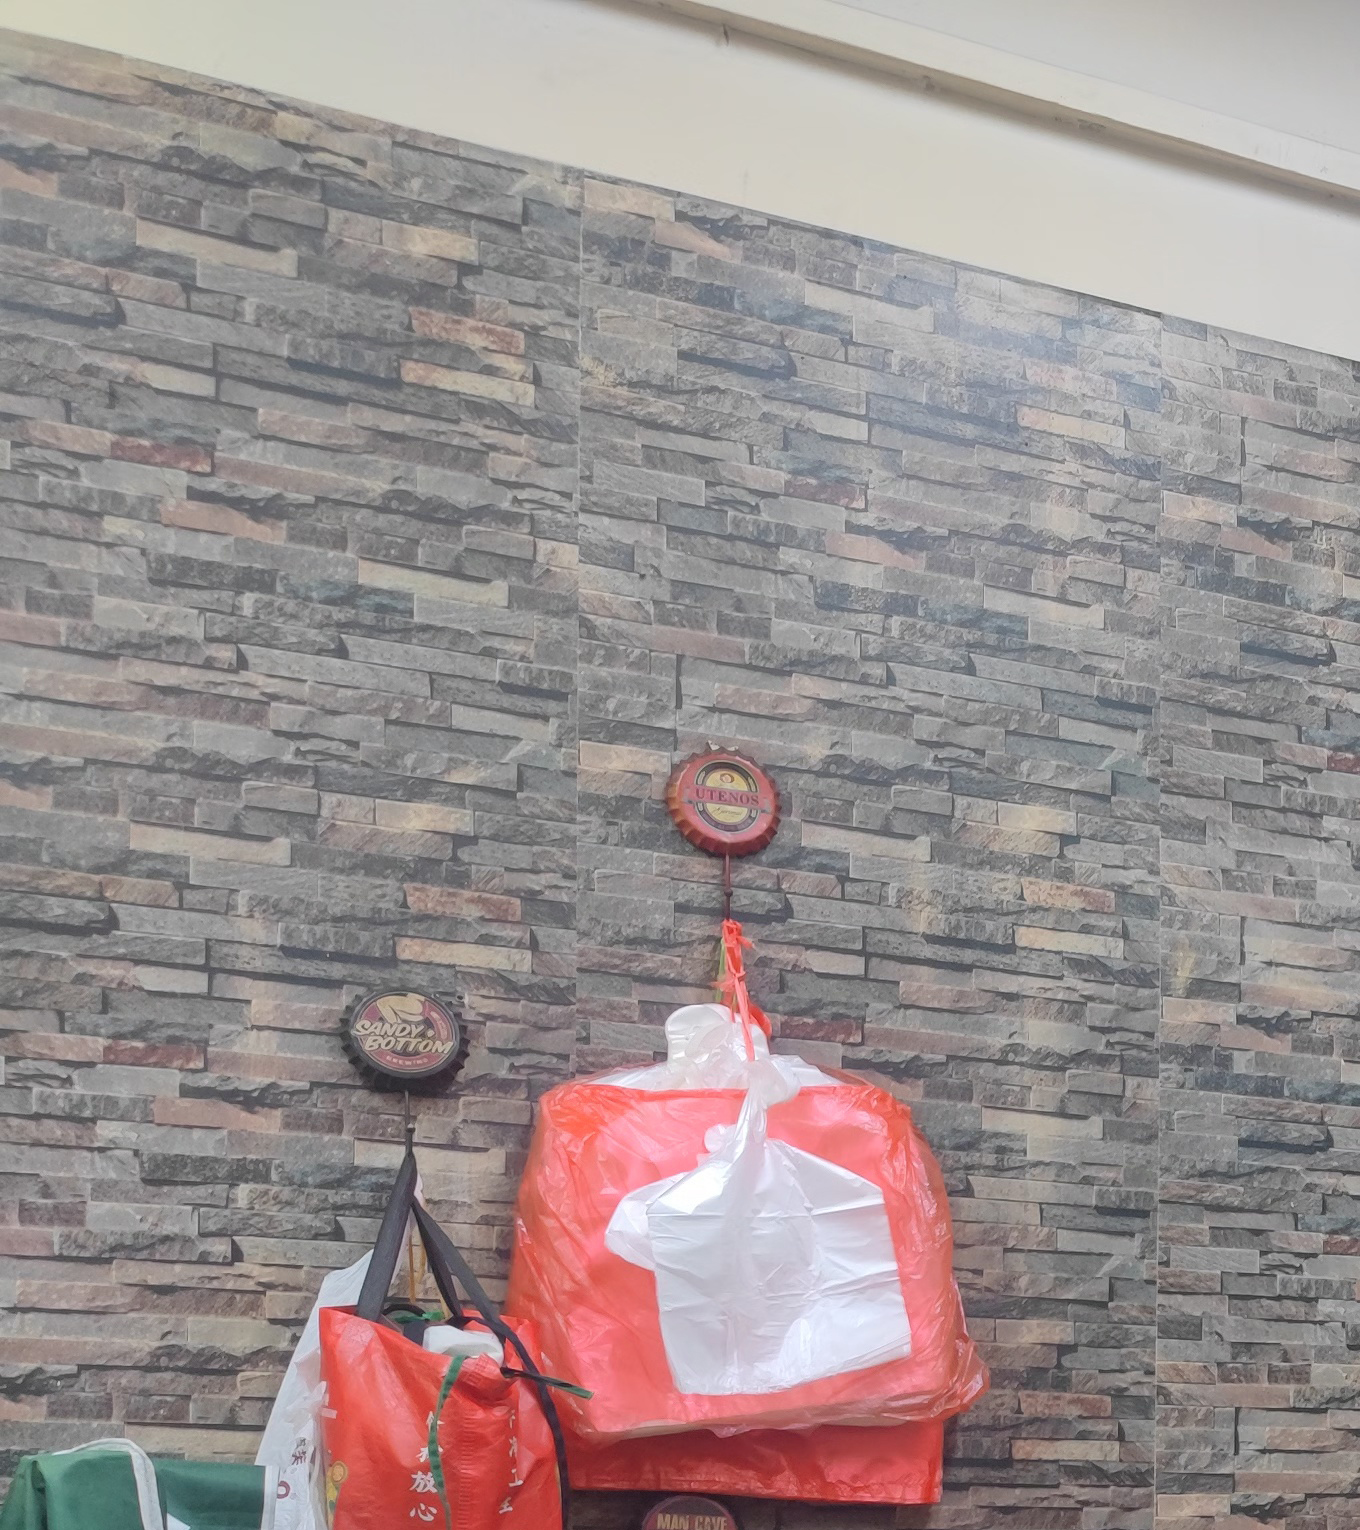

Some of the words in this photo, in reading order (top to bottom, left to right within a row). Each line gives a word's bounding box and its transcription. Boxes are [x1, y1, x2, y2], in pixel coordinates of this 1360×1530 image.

[695, 788, 760, 806] UTENOS
[353, 1020, 425, 1038] SANDY
[364, 1036, 454, 1054] BOTTOM
[657, 1513, 690, 1530] MAN
